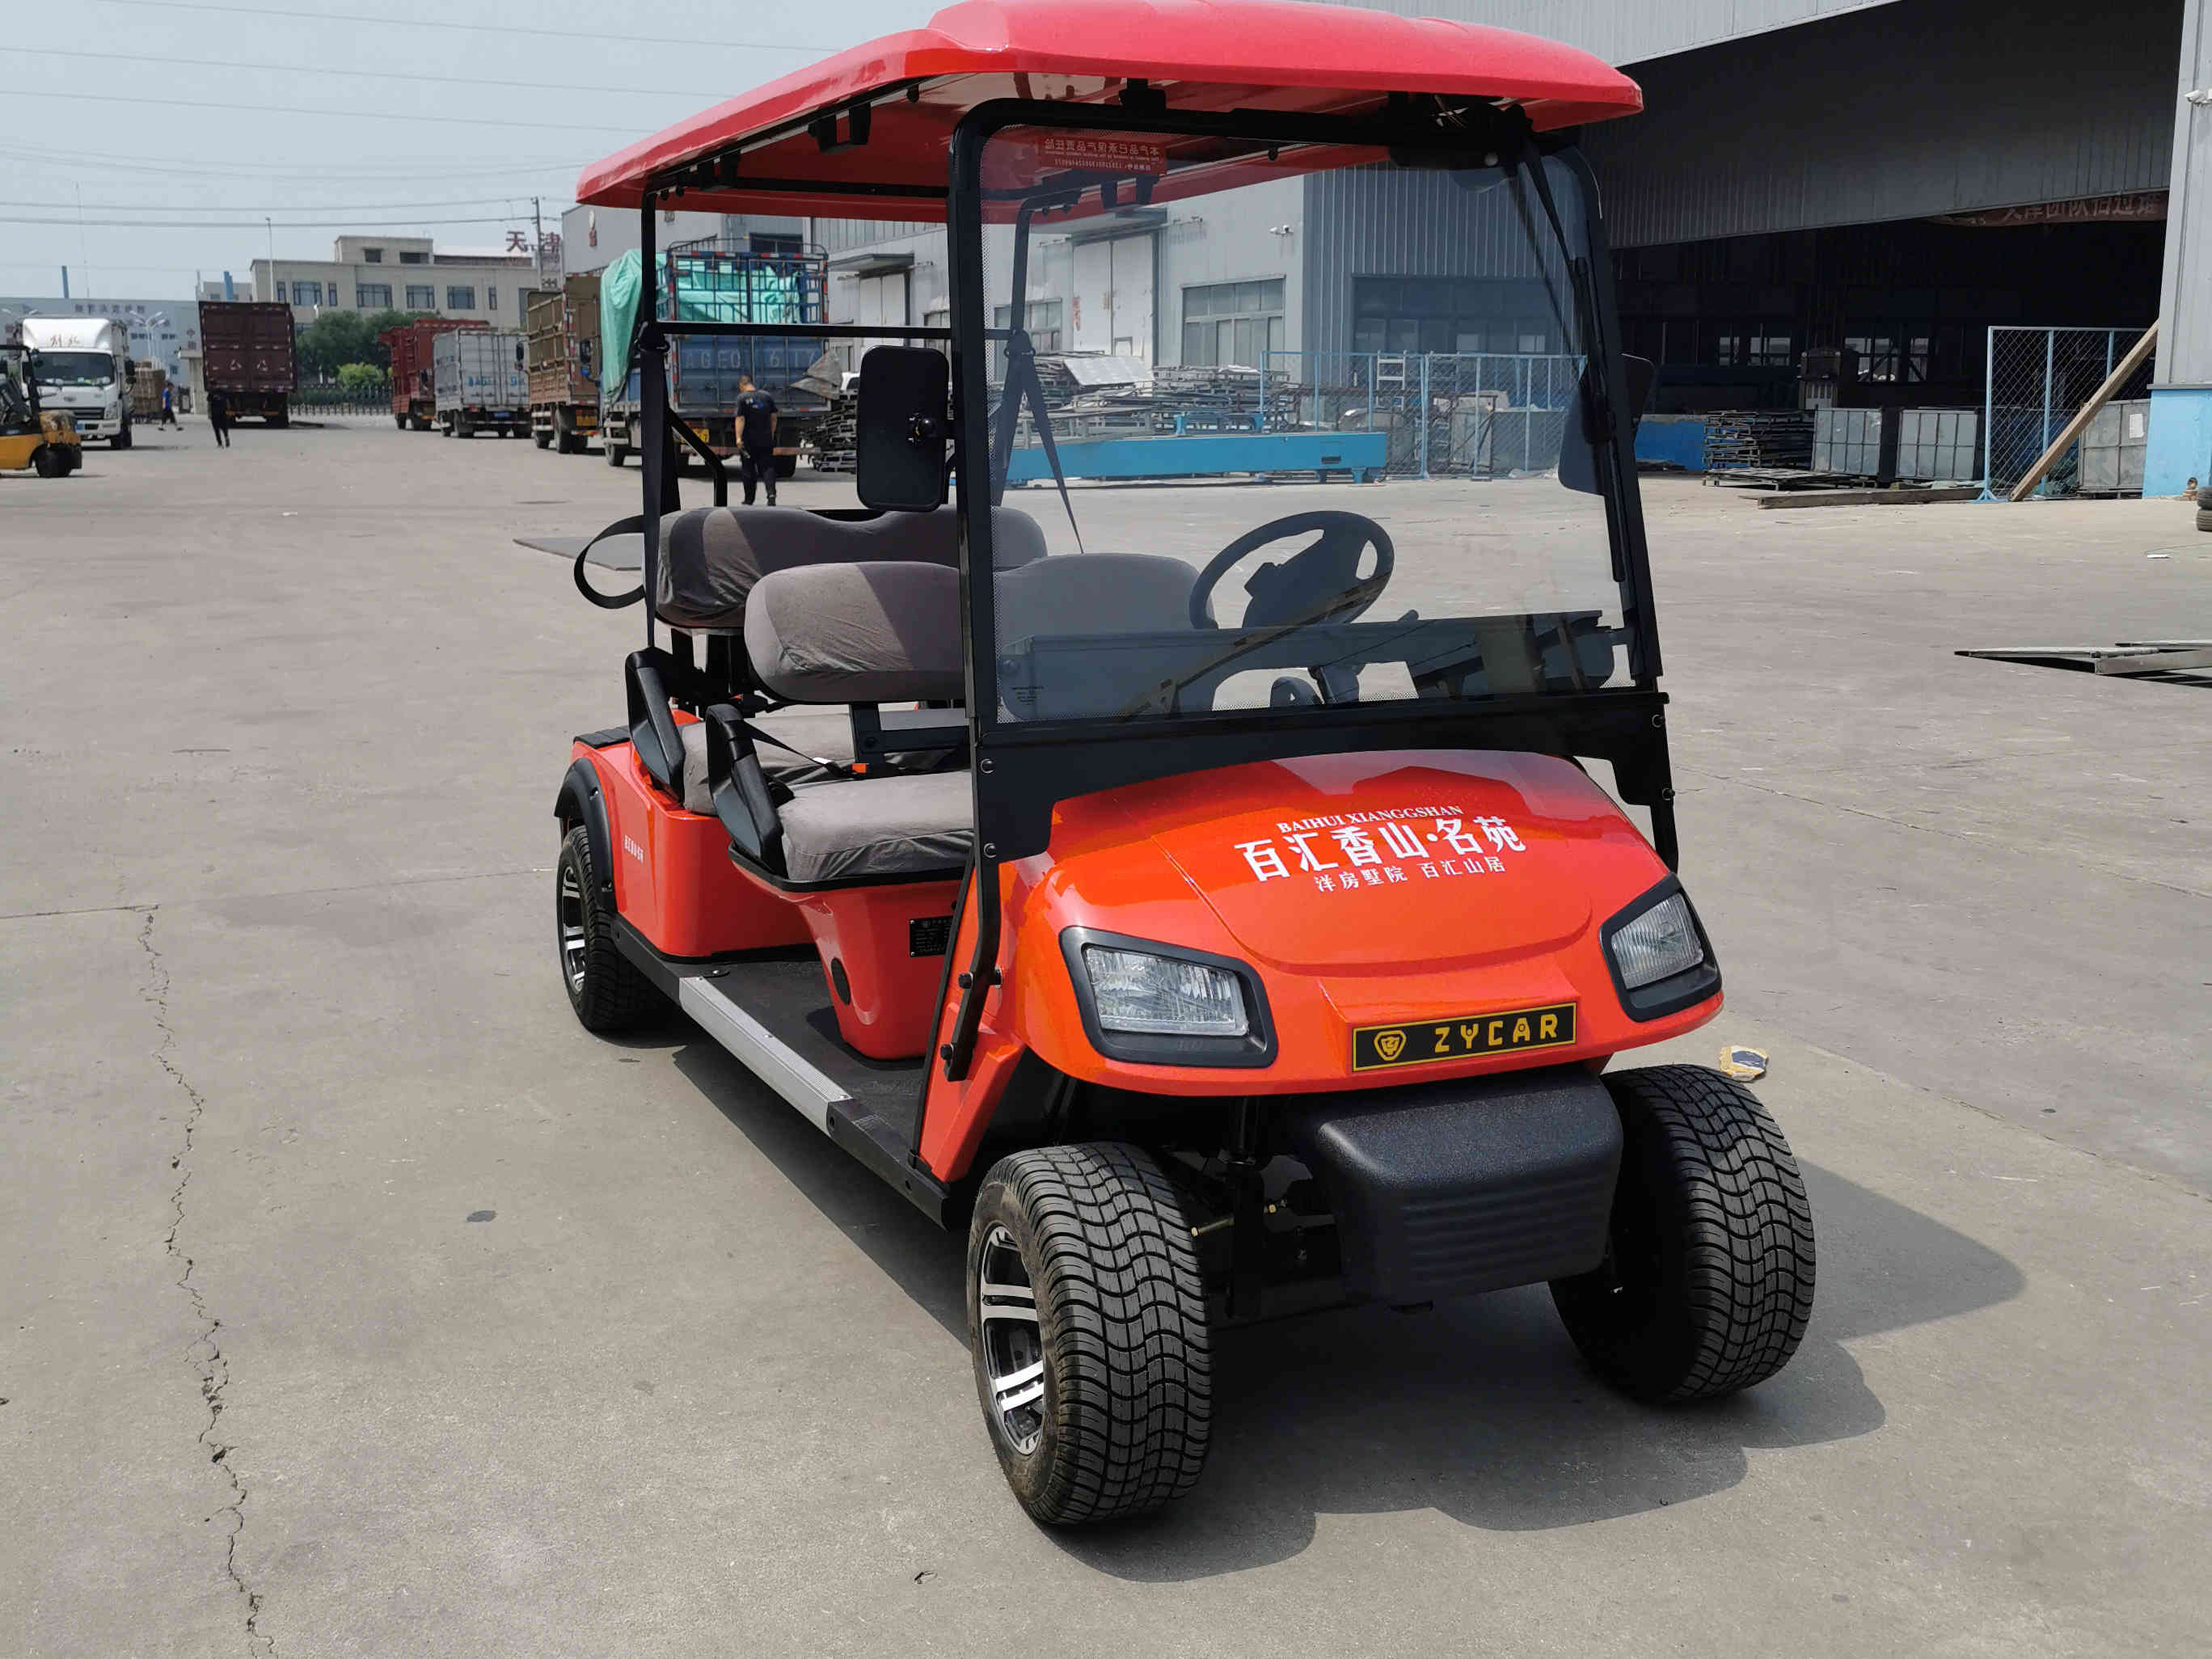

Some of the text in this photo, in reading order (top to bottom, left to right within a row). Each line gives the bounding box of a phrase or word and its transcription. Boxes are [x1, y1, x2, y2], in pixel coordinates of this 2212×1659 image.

[1276, 804, 1464, 834] BAIHUI XIANGGSHAN
[1235, 815, 1526, 882] 百汇香山·名苑
[1315, 855, 1505, 893] 洋房墅院 百汇山居
[1433, 1013, 1558, 1053] ZYCAR
